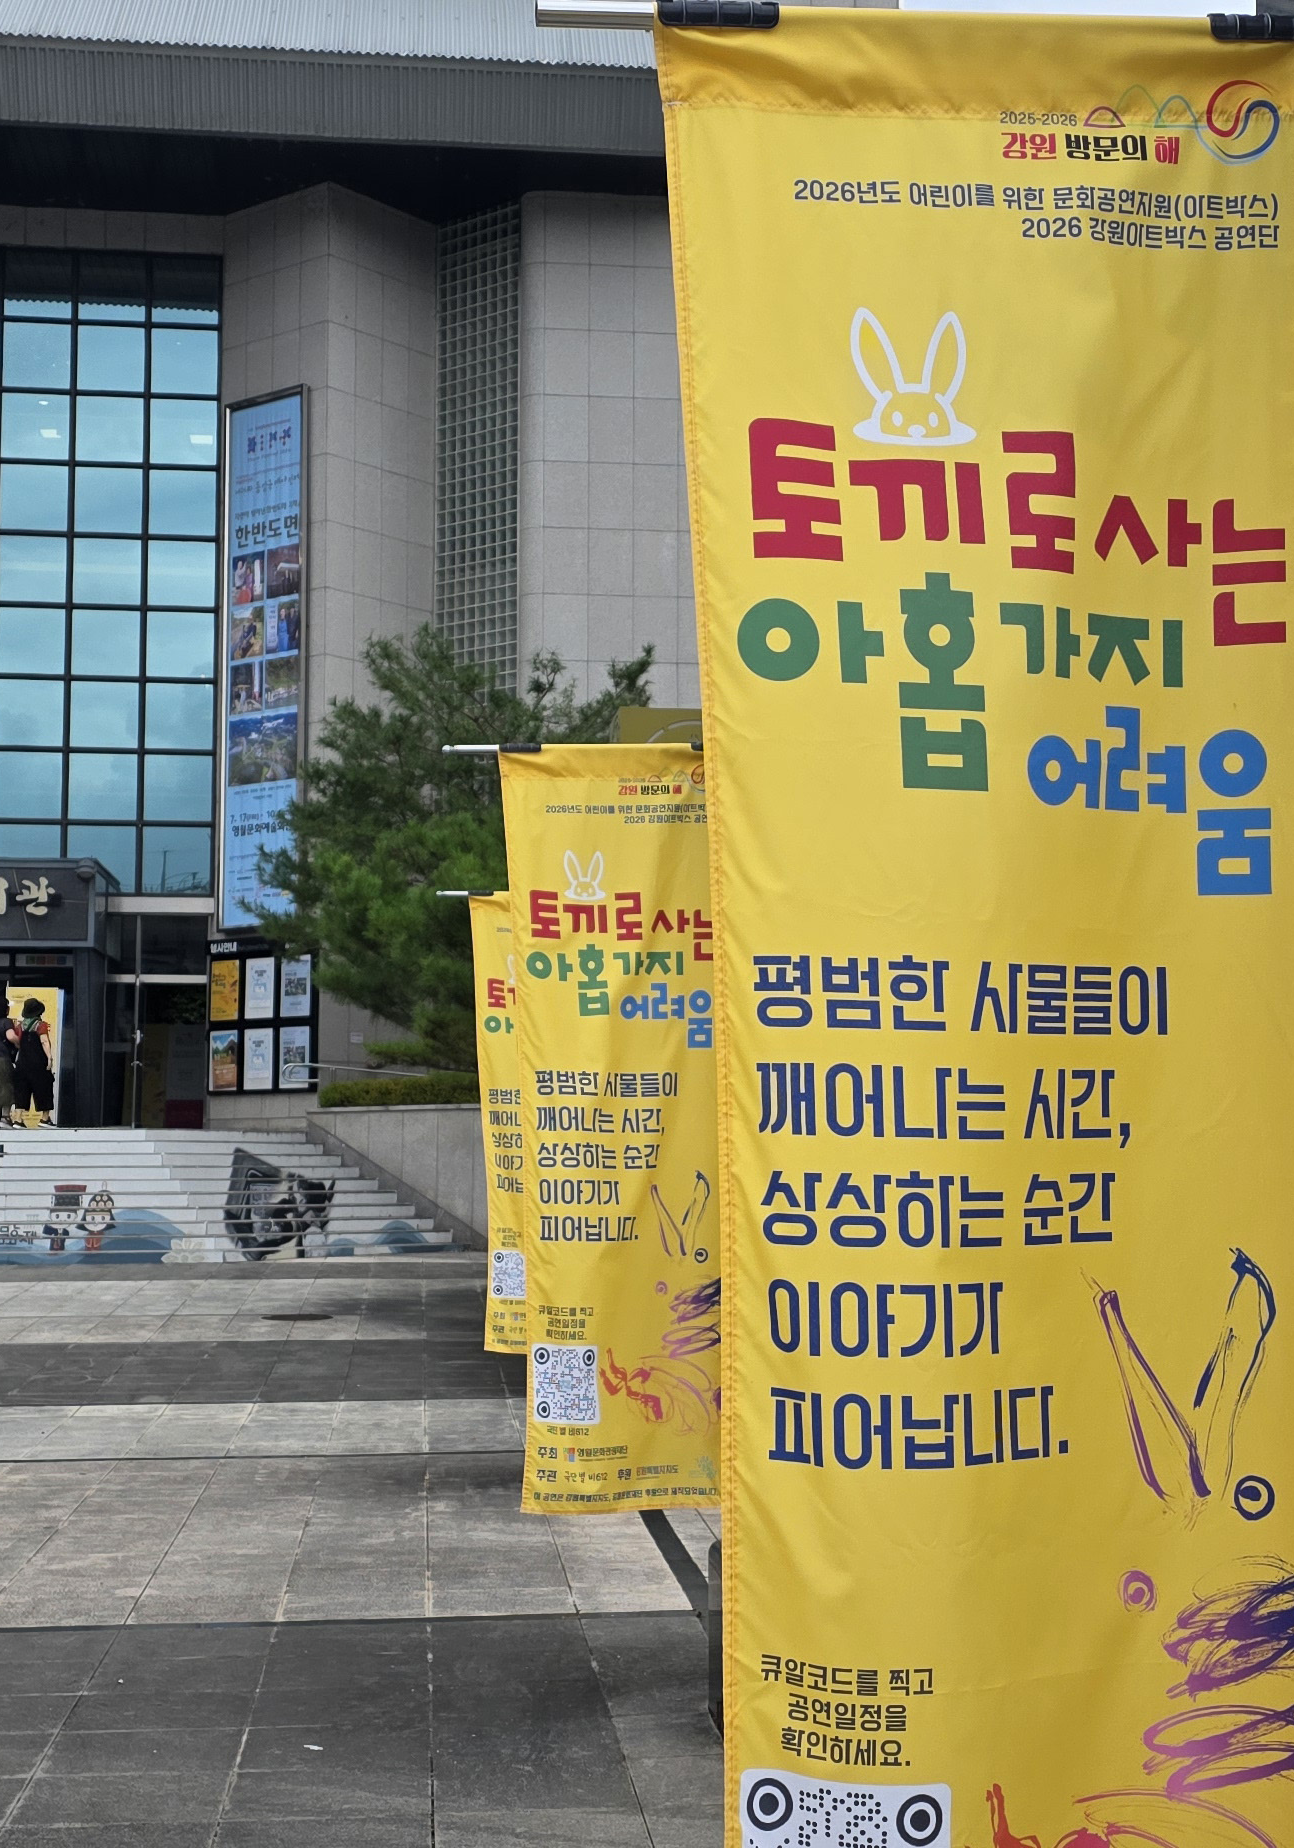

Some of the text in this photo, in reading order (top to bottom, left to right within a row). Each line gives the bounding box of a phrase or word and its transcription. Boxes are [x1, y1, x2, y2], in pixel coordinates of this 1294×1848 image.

[1000, 111, 1077, 127] 2025-2026
[1001, 132, 1180, 165] 강원 방문의 해
[794, 179, 1279, 221] 2026년도 어린이를 위한 문화공연지원(아트박스)
[1022, 217, 1280, 251] 2026 강원아트박스 공연단
[235, 513, 298, 548] 한반도면
[748, 417, 1288, 647] 토끼로 사는
[737, 571, 1184, 792] 아홉 가지
[545, 804, 583, 814] 2026년도
[635, 803, 706, 814] 문화공연지원(아트박
[1027, 705, 1273, 896] 어려움
[529, 889, 713, 961] 토끼로 사는
[526, 943, 684, 1016] 아홉 가지
[752, 954, 1169, 1037] 평범한 사물들이
[620, 982, 713, 1049] 어려움
[534, 1070, 679, 1098] 평범한 사물들이
[536, 1106, 665, 1136] 깨어나는 시간,
[756, 1062, 1132, 1149] 깨어나는 시간,
[537, 1142, 660, 1170] 상상하는 순간
[539, 1179, 620, 1205] 이야기가
[761, 1170, 1116, 1249] 상상하는 순간
[540, 1215, 639, 1242] 피어납니다.
[768, 1278, 1004, 1359] 이야기가
[769, 1385, 1070, 1471] 피어납니다.
[537, 1446, 558, 1460] 주최
[536, 1469, 558, 1483] 주관
[760, 1653, 934, 1697] 큐알코드를 찍고
[788, 1692, 907, 1732] 공연일정을
[780, 1726, 911, 1767] 확인하세요.
